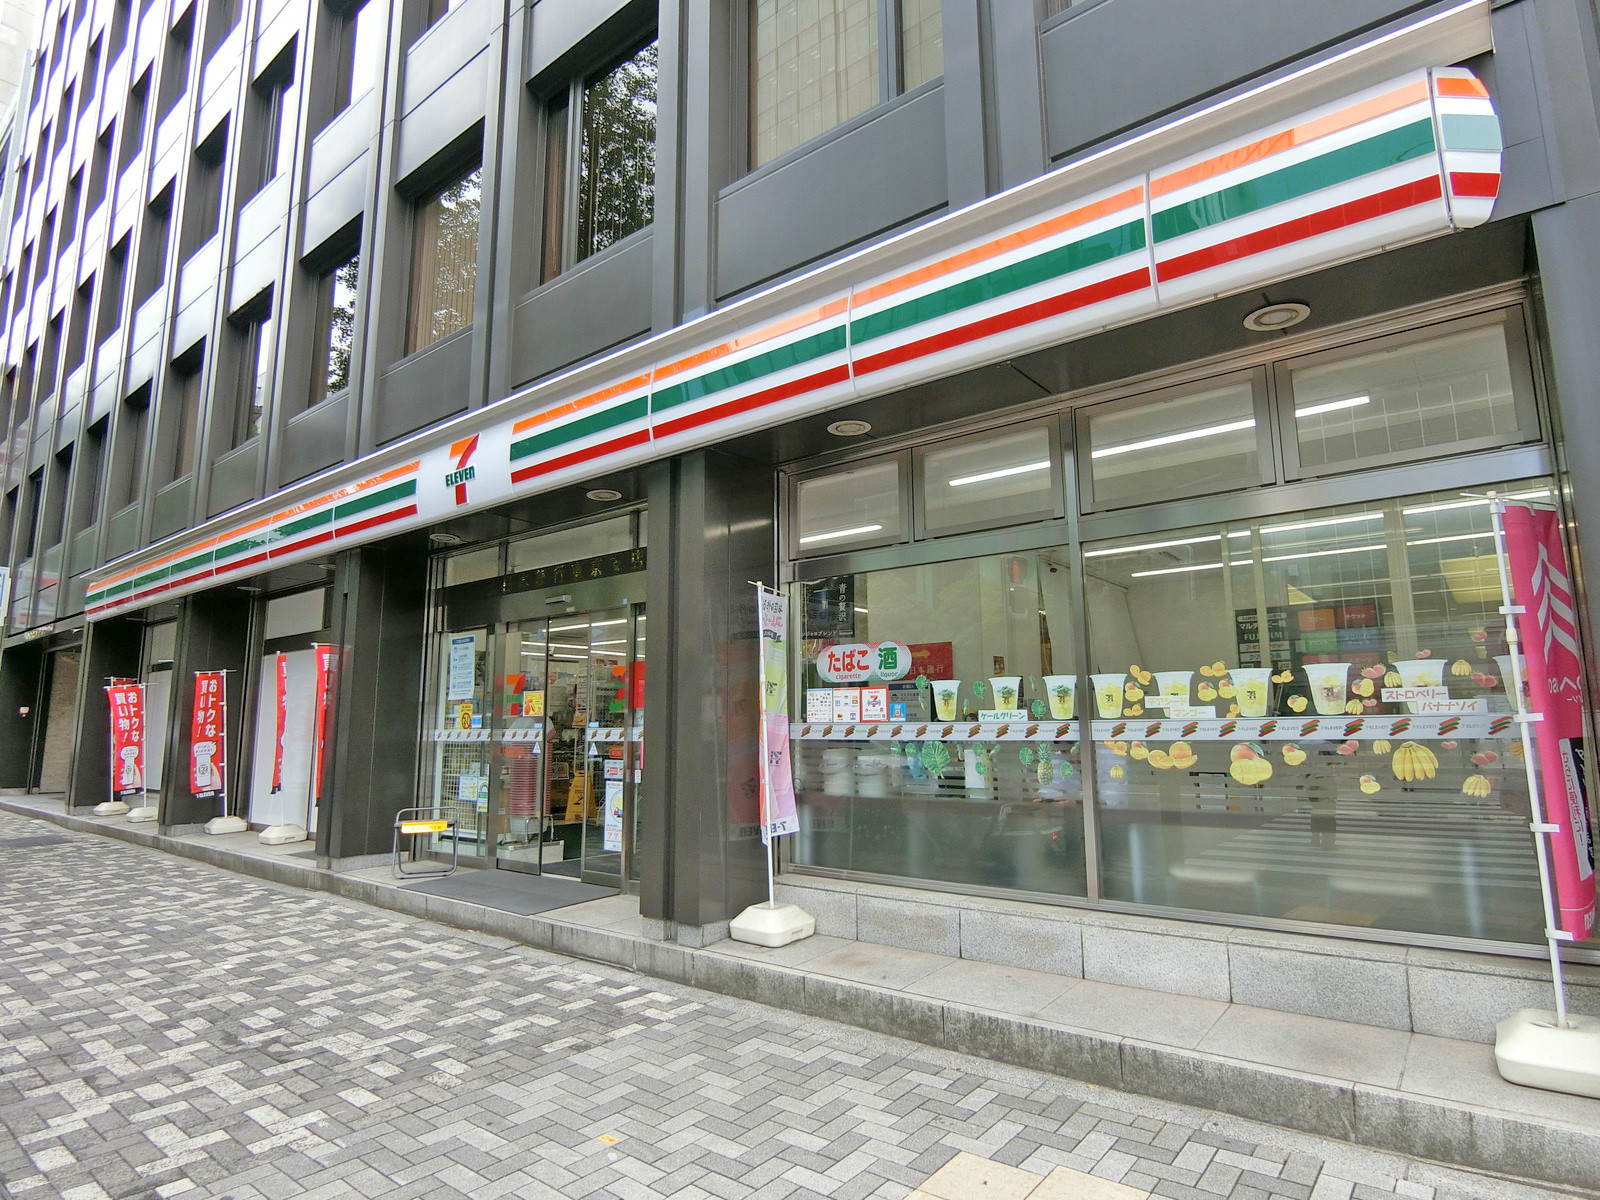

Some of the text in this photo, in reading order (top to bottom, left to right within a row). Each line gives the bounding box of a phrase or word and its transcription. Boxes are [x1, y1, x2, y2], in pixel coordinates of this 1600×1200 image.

[450, 432, 480, 505] 7
[828, 647, 898, 673] たばこ 酒
[880, 671, 899, 679] liquor
[909, 665, 944, 675] 日本銀行
[1385, 689, 1448, 700] ストロベリー
[205, 679, 218, 738] おトクな
[1422, 701, 1478, 712] バナナソイ
[115, 692, 131, 743] 買い物！
[128, 691, 140, 742] おトクな
[980, 711, 1026, 720] ケールグリーン
[1173, 709, 1207, 717] マンゴー
